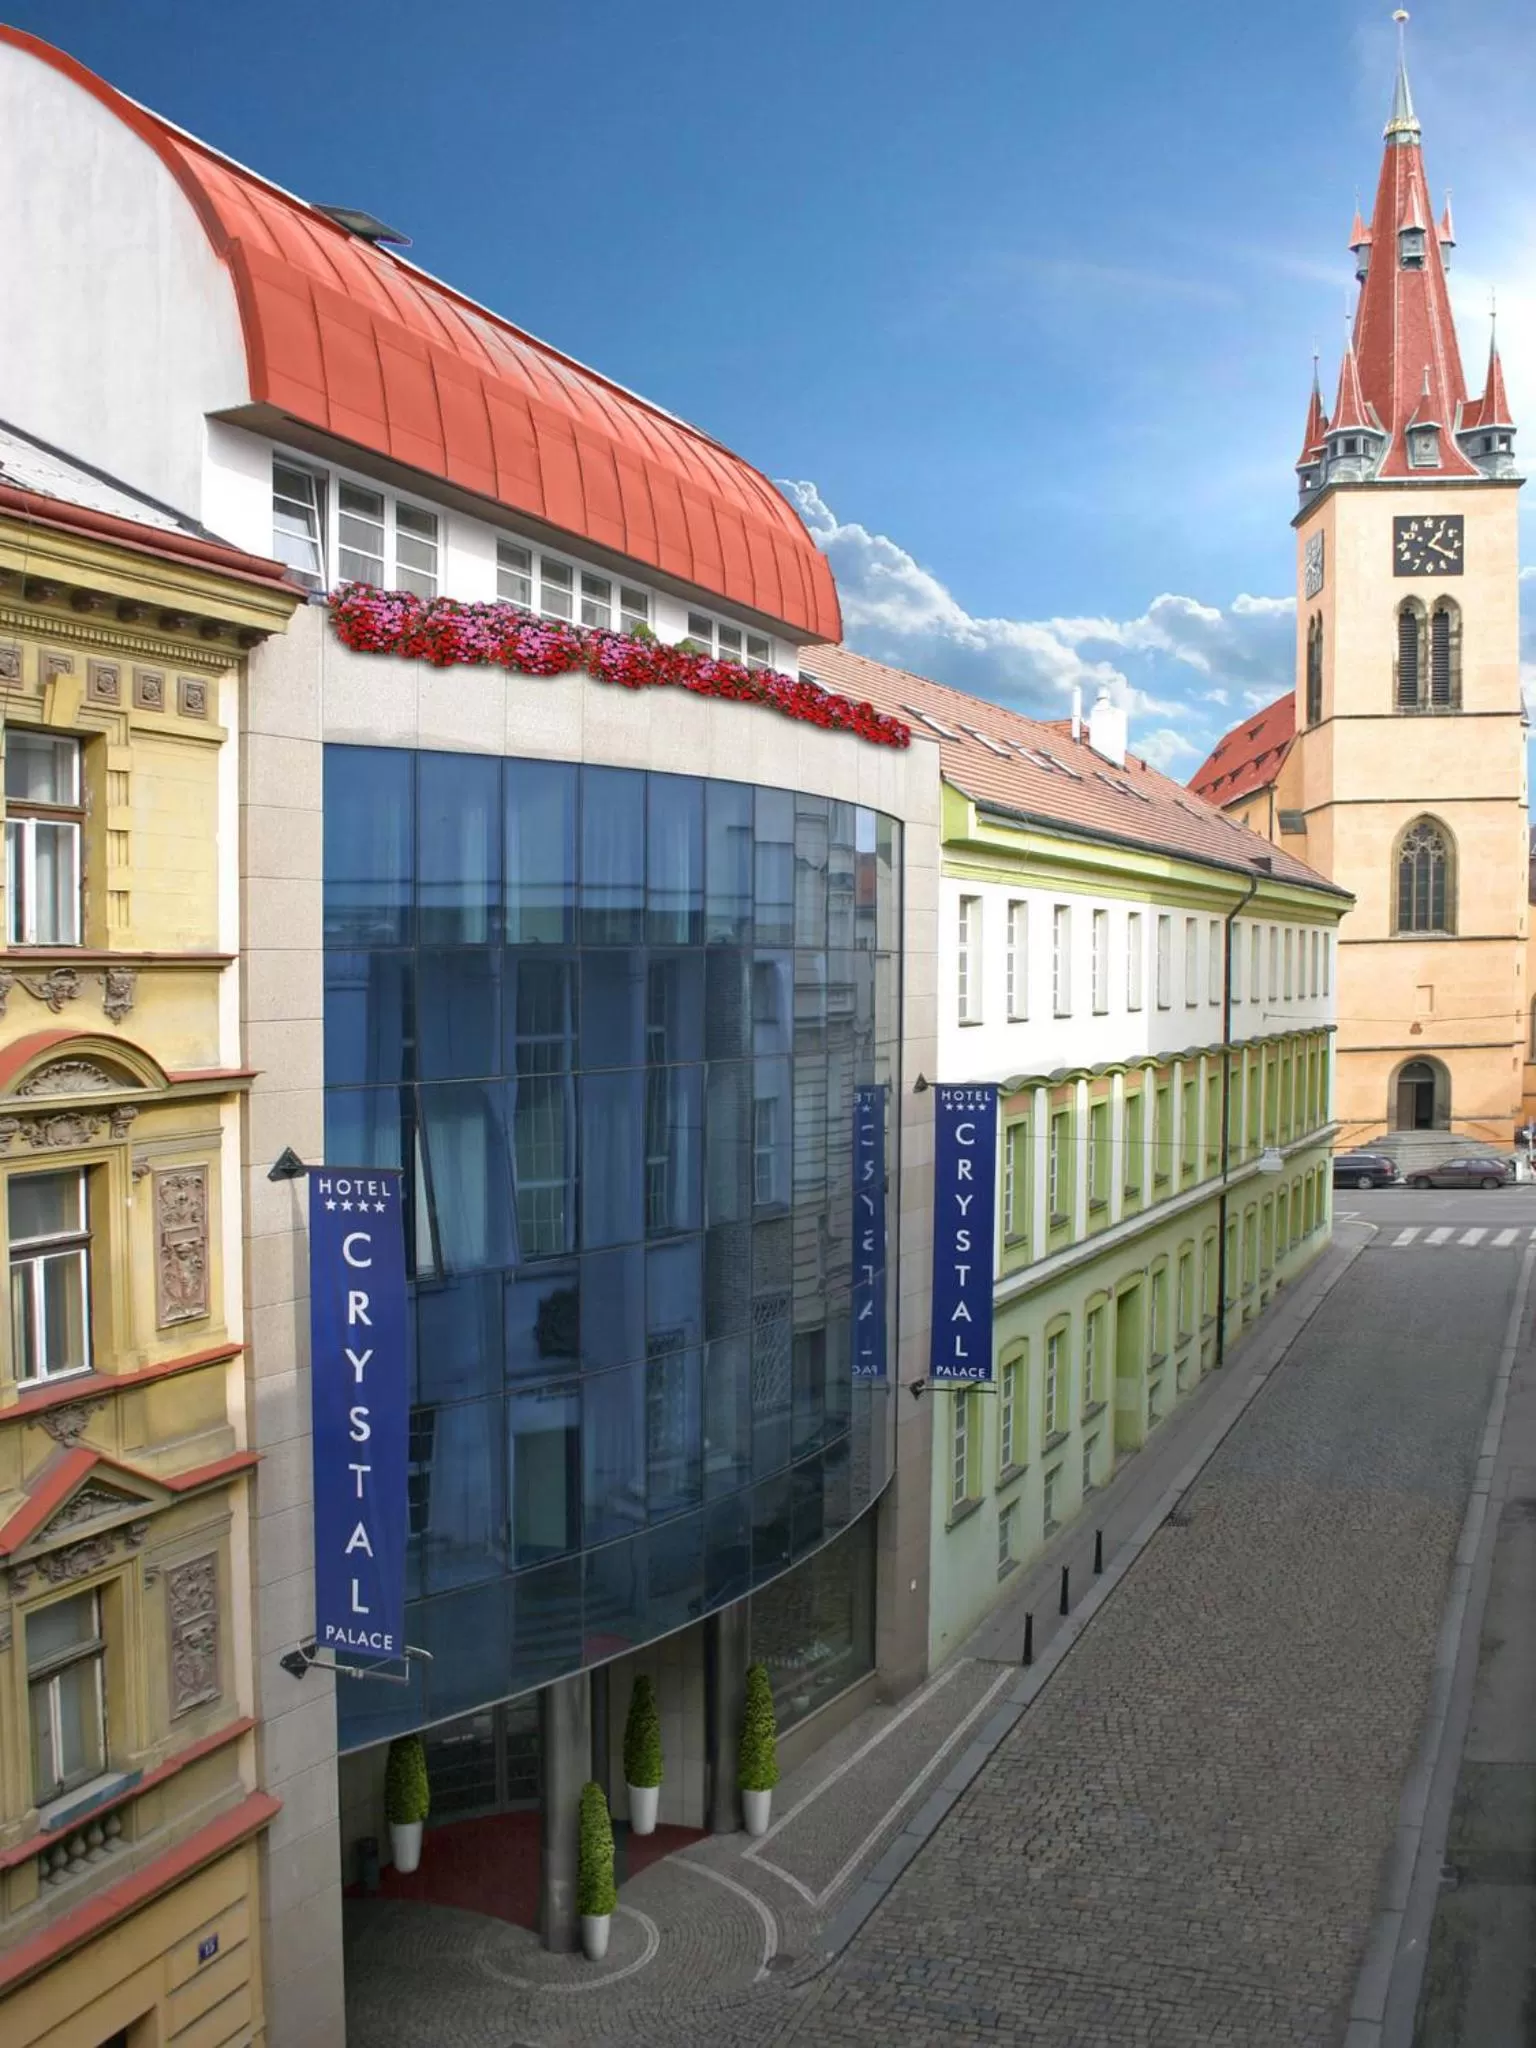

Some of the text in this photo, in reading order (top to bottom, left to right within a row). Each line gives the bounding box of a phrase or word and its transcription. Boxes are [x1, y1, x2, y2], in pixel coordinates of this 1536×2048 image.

[941, 1090, 991, 1102] HOTEL
[319, 1179, 391, 1197] HOTEL
[952, 1123, 975, 1357] CRYSTAL
[936, 1366, 985, 1378] PALACE
[342, 1232, 373, 1613] CRYSTAL
[325, 1625, 393, 1650] PALACE
